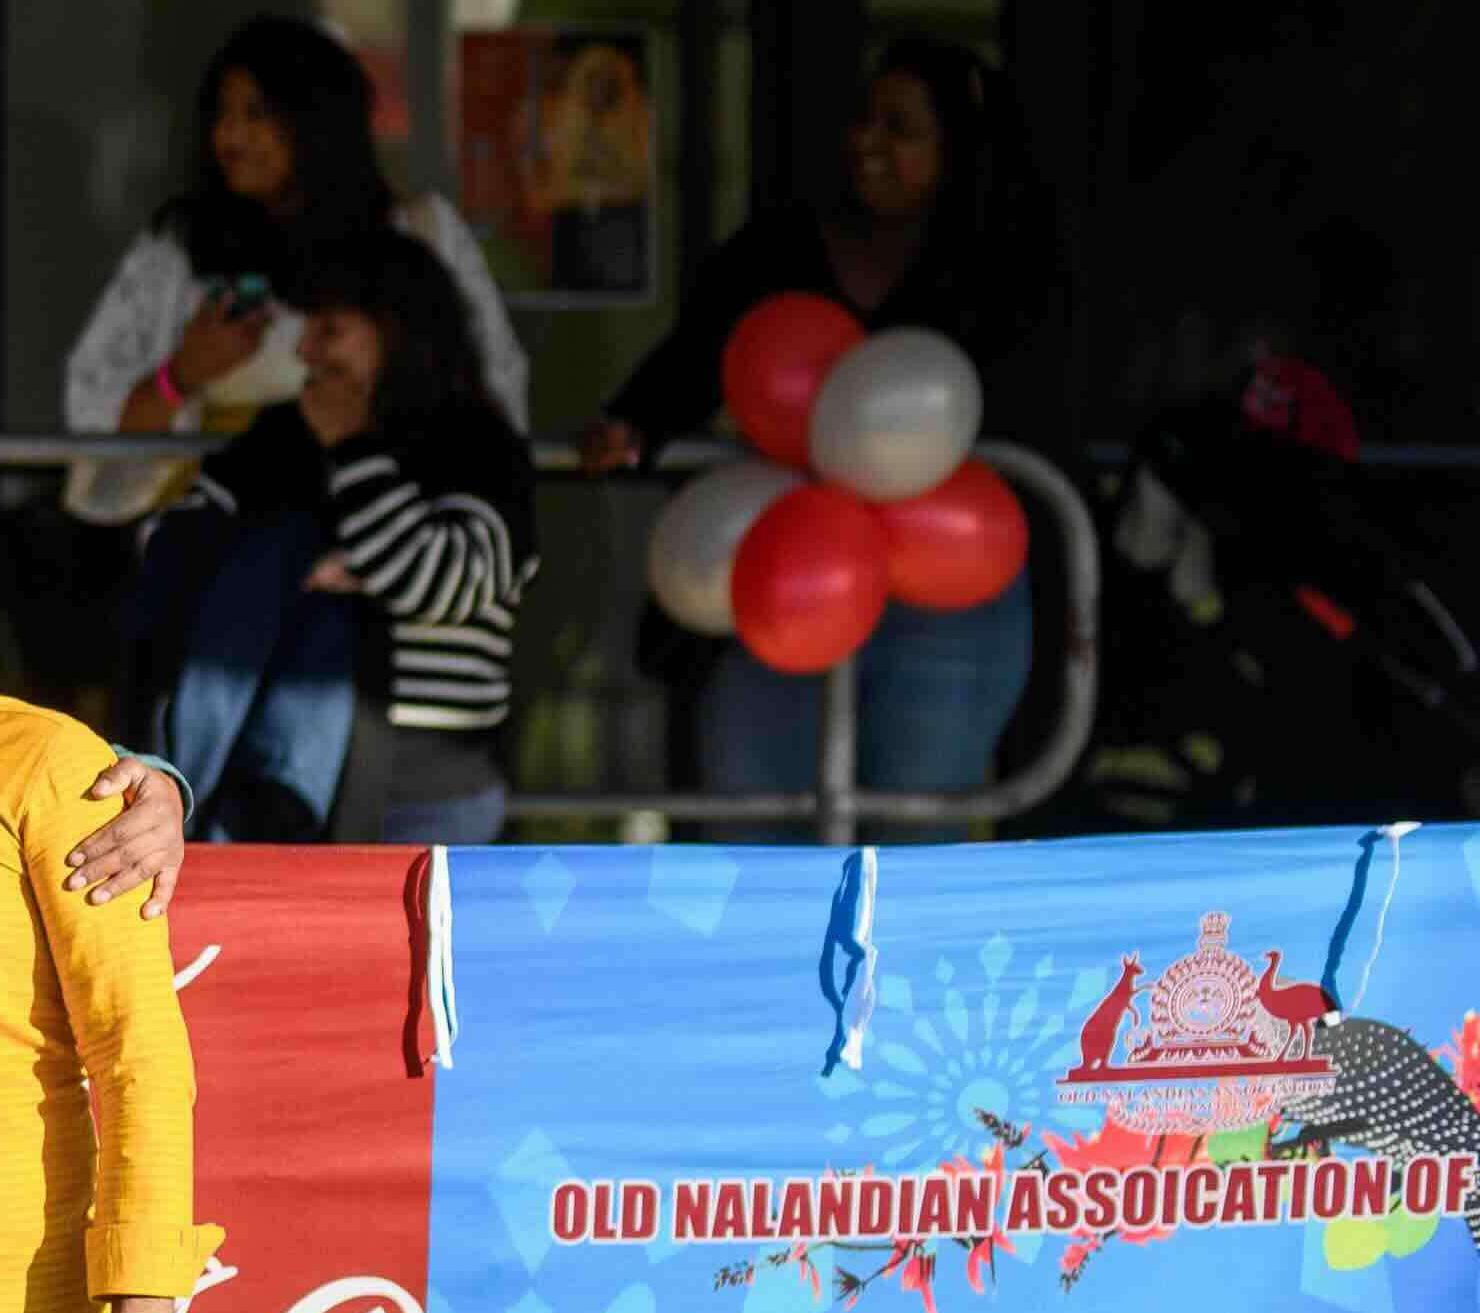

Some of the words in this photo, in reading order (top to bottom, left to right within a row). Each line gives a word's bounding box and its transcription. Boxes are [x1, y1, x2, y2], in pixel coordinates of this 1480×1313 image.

[552, 1183, 657, 1240] OLD
[674, 1177, 992, 1239] NALANDIAN
[1006, 1160, 1387, 1231] ASSOICATION
[1405, 1158, 1474, 1214] OF
